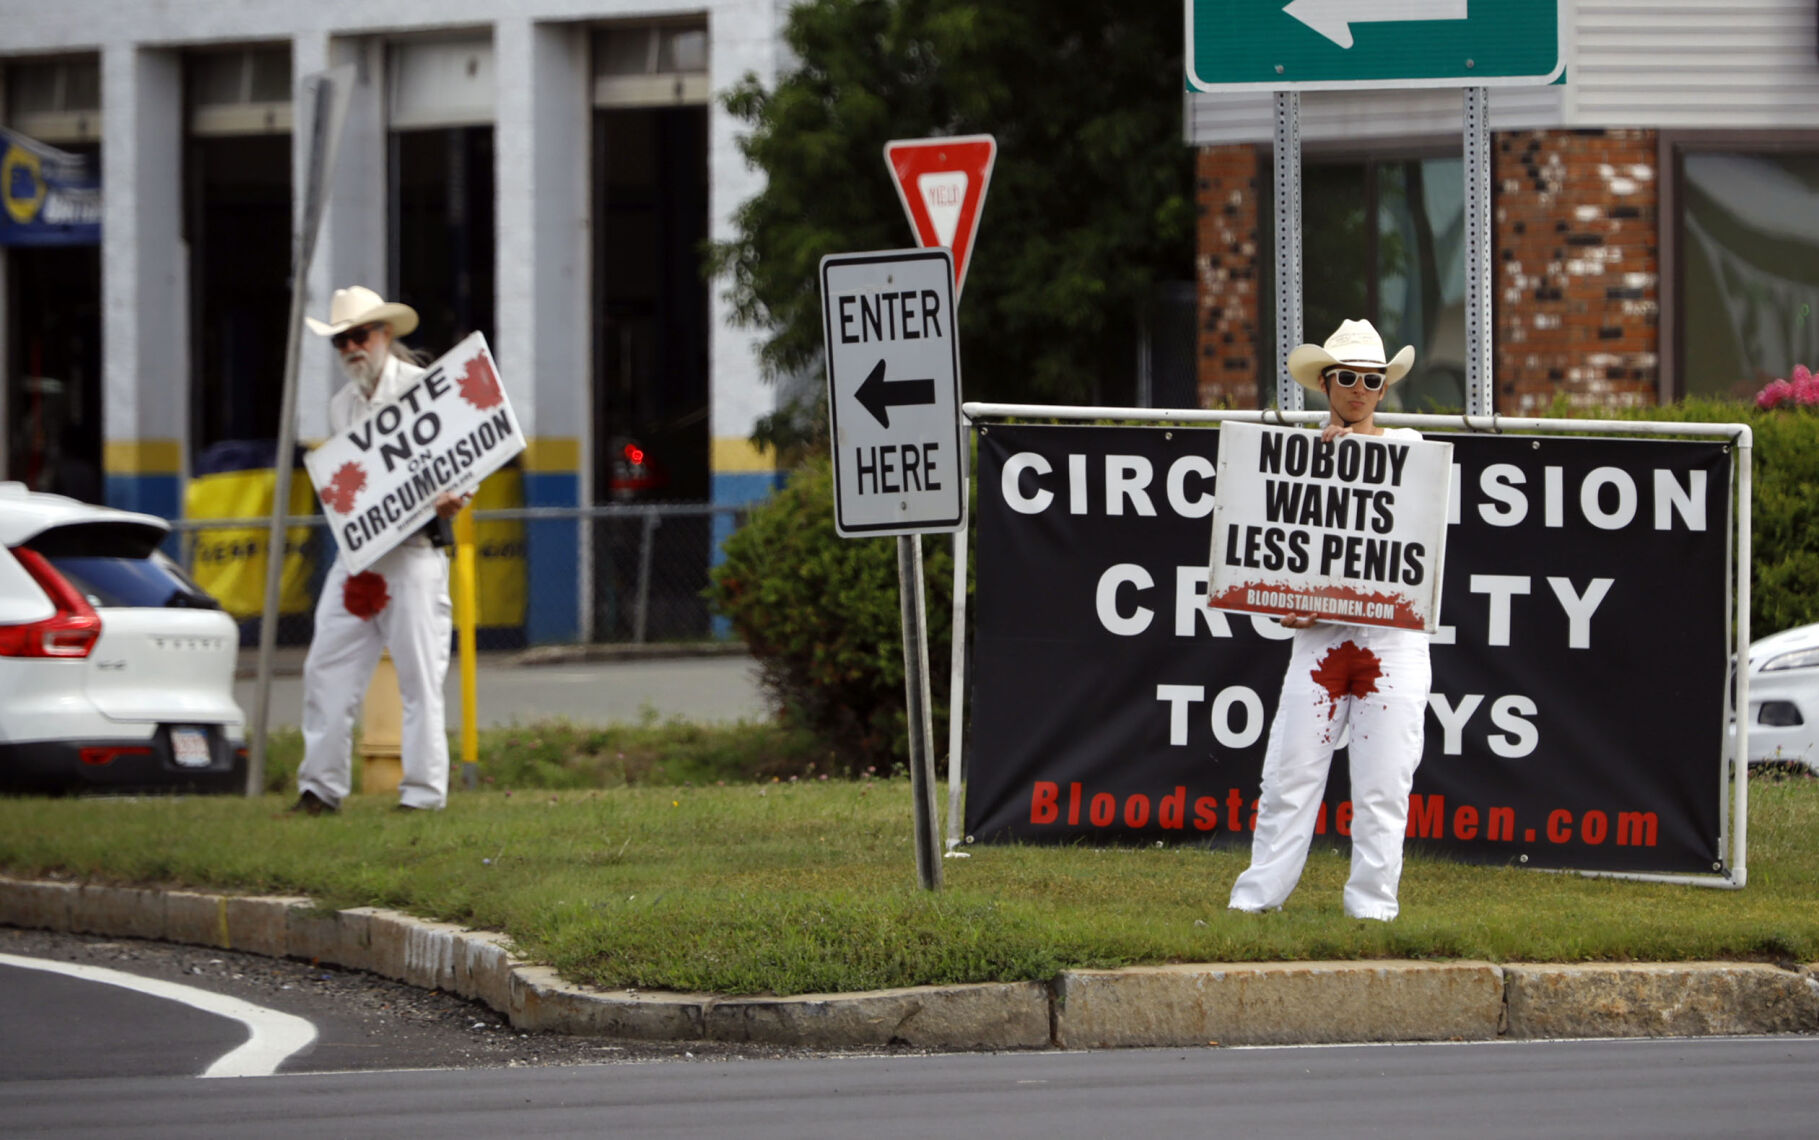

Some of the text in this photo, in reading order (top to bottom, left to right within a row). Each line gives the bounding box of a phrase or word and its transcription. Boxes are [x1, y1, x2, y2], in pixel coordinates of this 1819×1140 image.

[929, 184, 959, 207] YIELD
[838, 289, 943, 344] ENTER
[348, 366, 452, 452] VOTE
[379, 412, 441, 472] NO
[408, 449, 433, 473] ON
[856, 442, 942, 495] HERE
[1259, 431, 1410, 487] NOBODY
[343, 410, 513, 551] CIRCUMCISION
[1001, 452, 1708, 531] CIRCISION
[1266, 479, 1395, 534] WANTS
[1225, 524, 1425, 586] LESS PENIS
[1095, 563, 1615, 650] CRTY
[1247, 589, 1395, 619] BLOODSTAINEDMEN.COM
[1156, 684, 1264, 748] TO
